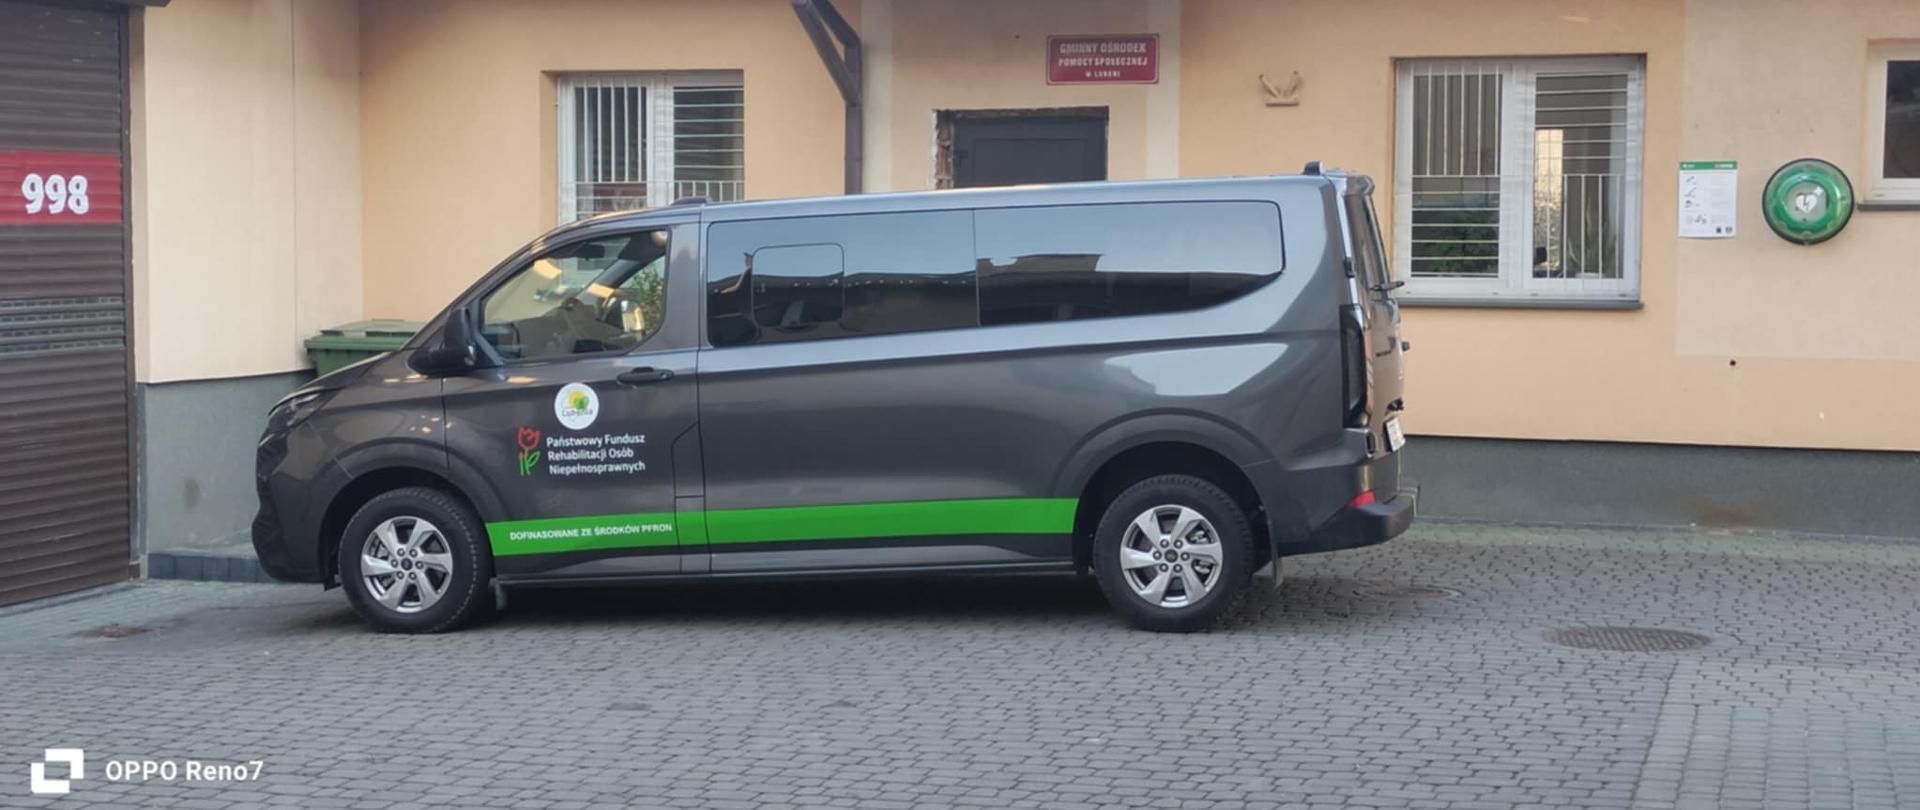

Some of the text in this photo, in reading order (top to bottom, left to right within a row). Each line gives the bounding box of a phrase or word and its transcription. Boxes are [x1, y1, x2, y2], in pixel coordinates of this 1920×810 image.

[1059, 43, 1097, 53] GMINNY
[1058, 57, 1093, 66] POMOCY
[22, 173, 89, 214] 998
[546, 433, 646, 447] Państwowy Fundusz
[547, 447, 634, 461] Rehabilitacji Osób
[548, 460, 646, 475] Niepełnosprawnych
[581, 527, 592, 536] ZE
[594, 523, 640, 536] ŚRODKÓW
[642, 523, 672, 532] PFRON
